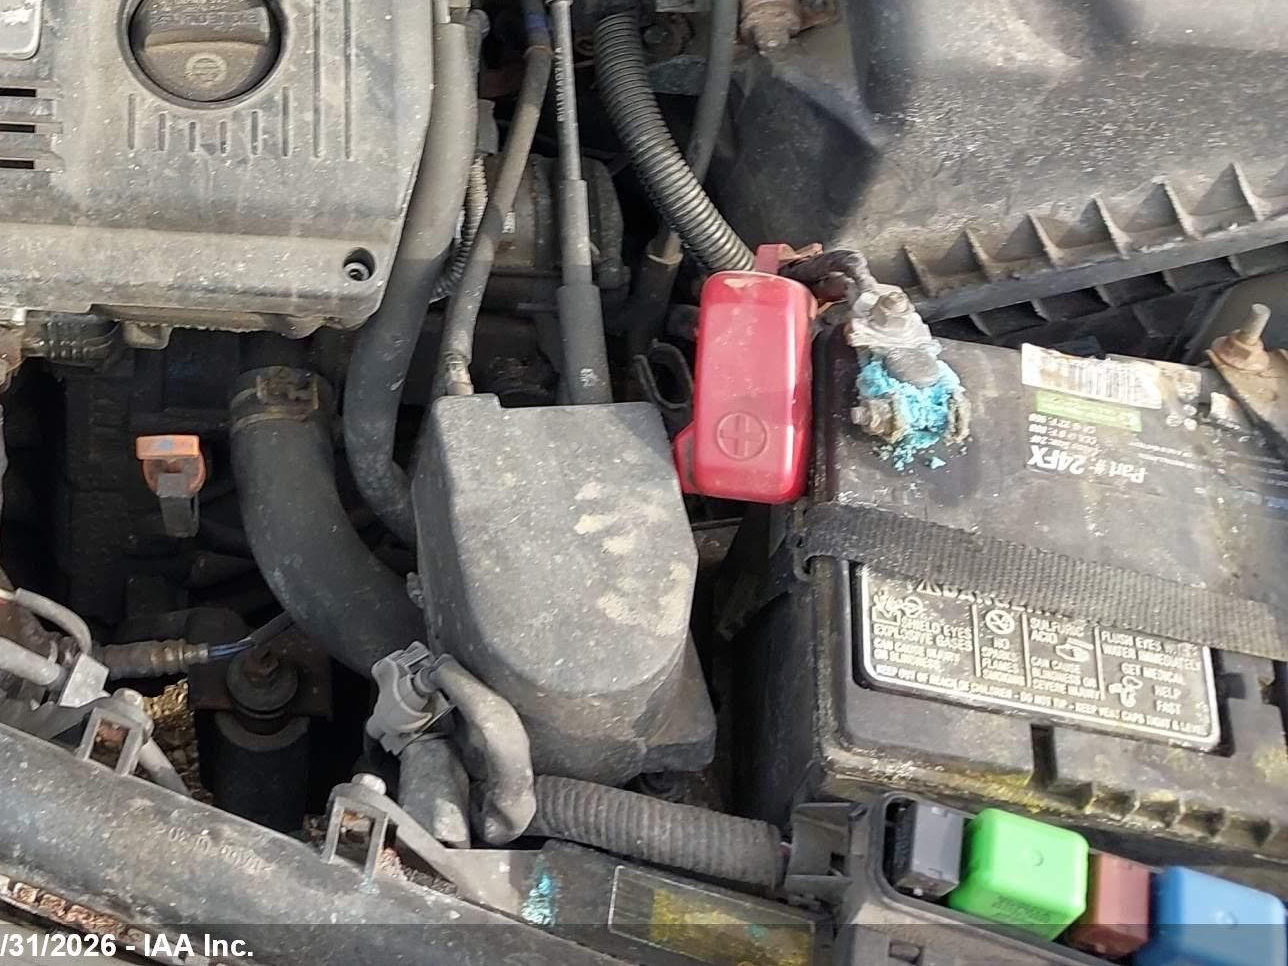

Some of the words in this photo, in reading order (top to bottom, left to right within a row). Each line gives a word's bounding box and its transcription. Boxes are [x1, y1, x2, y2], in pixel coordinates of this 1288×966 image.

[1027, 445, 1087, 475] 24FX
[1109, 460, 1146, 483] Part
[873, 623, 934, 646] EXPLOSIVE
[935, 634, 973, 652] GASES
[900, 615, 942, 635] SHIELD
[943, 624, 973, 641] EYES
[1030, 629, 1058, 645] ACID
[1100, 630, 1134, 647] FLUSH
[1135, 636, 1163, 652] EYES
[1120, 662, 1143, 677] GET
[1154, 685, 1183, 701] HELP
[1155, 700, 1182, 716] FAST
